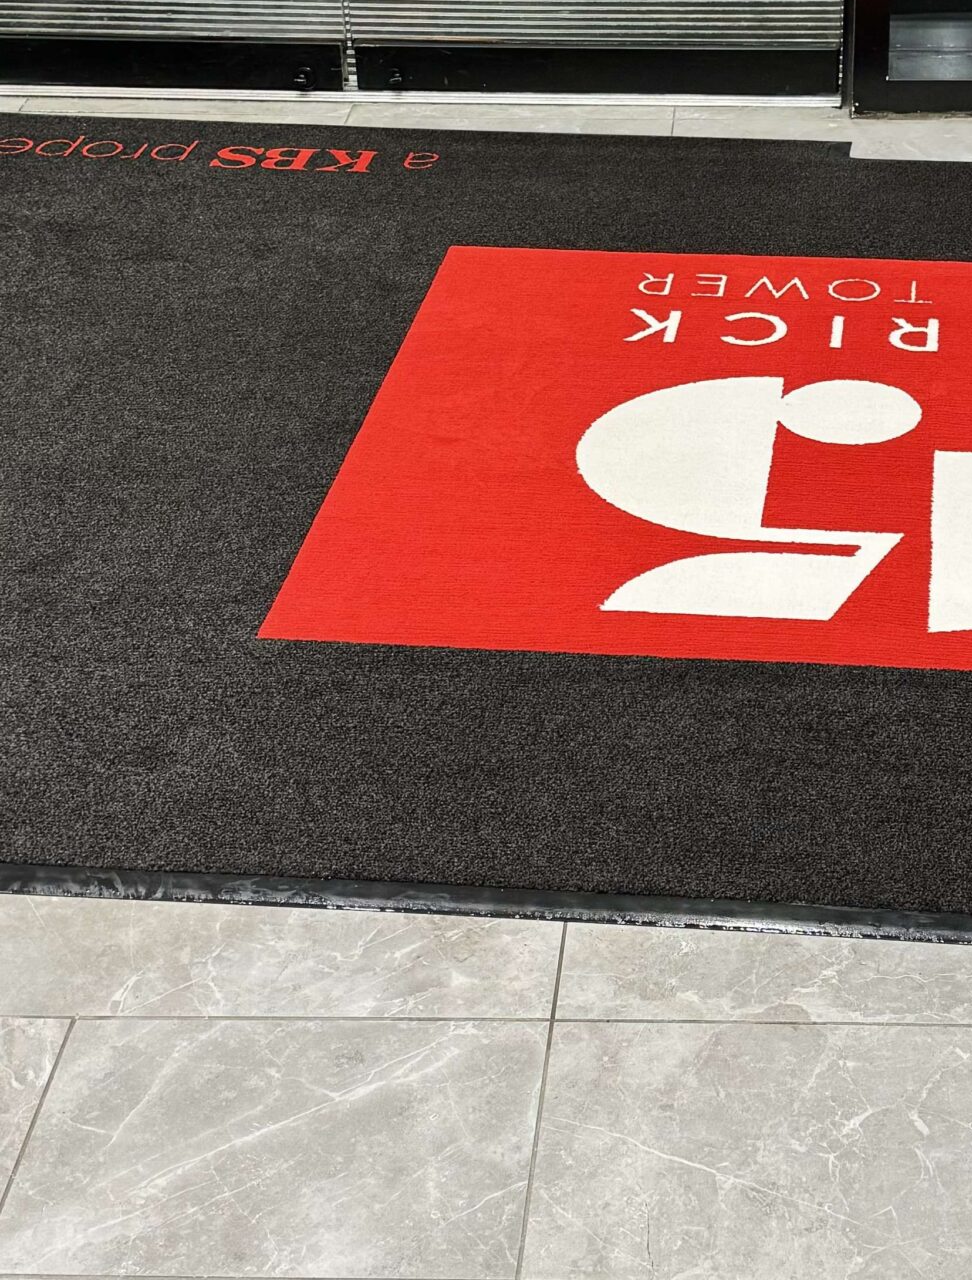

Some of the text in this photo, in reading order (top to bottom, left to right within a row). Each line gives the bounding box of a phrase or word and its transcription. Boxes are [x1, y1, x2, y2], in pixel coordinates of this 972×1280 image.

[209, 146, 378, 174] KBS
[402, 151, 441, 170] a
[638, 272, 934, 304] TOWER
